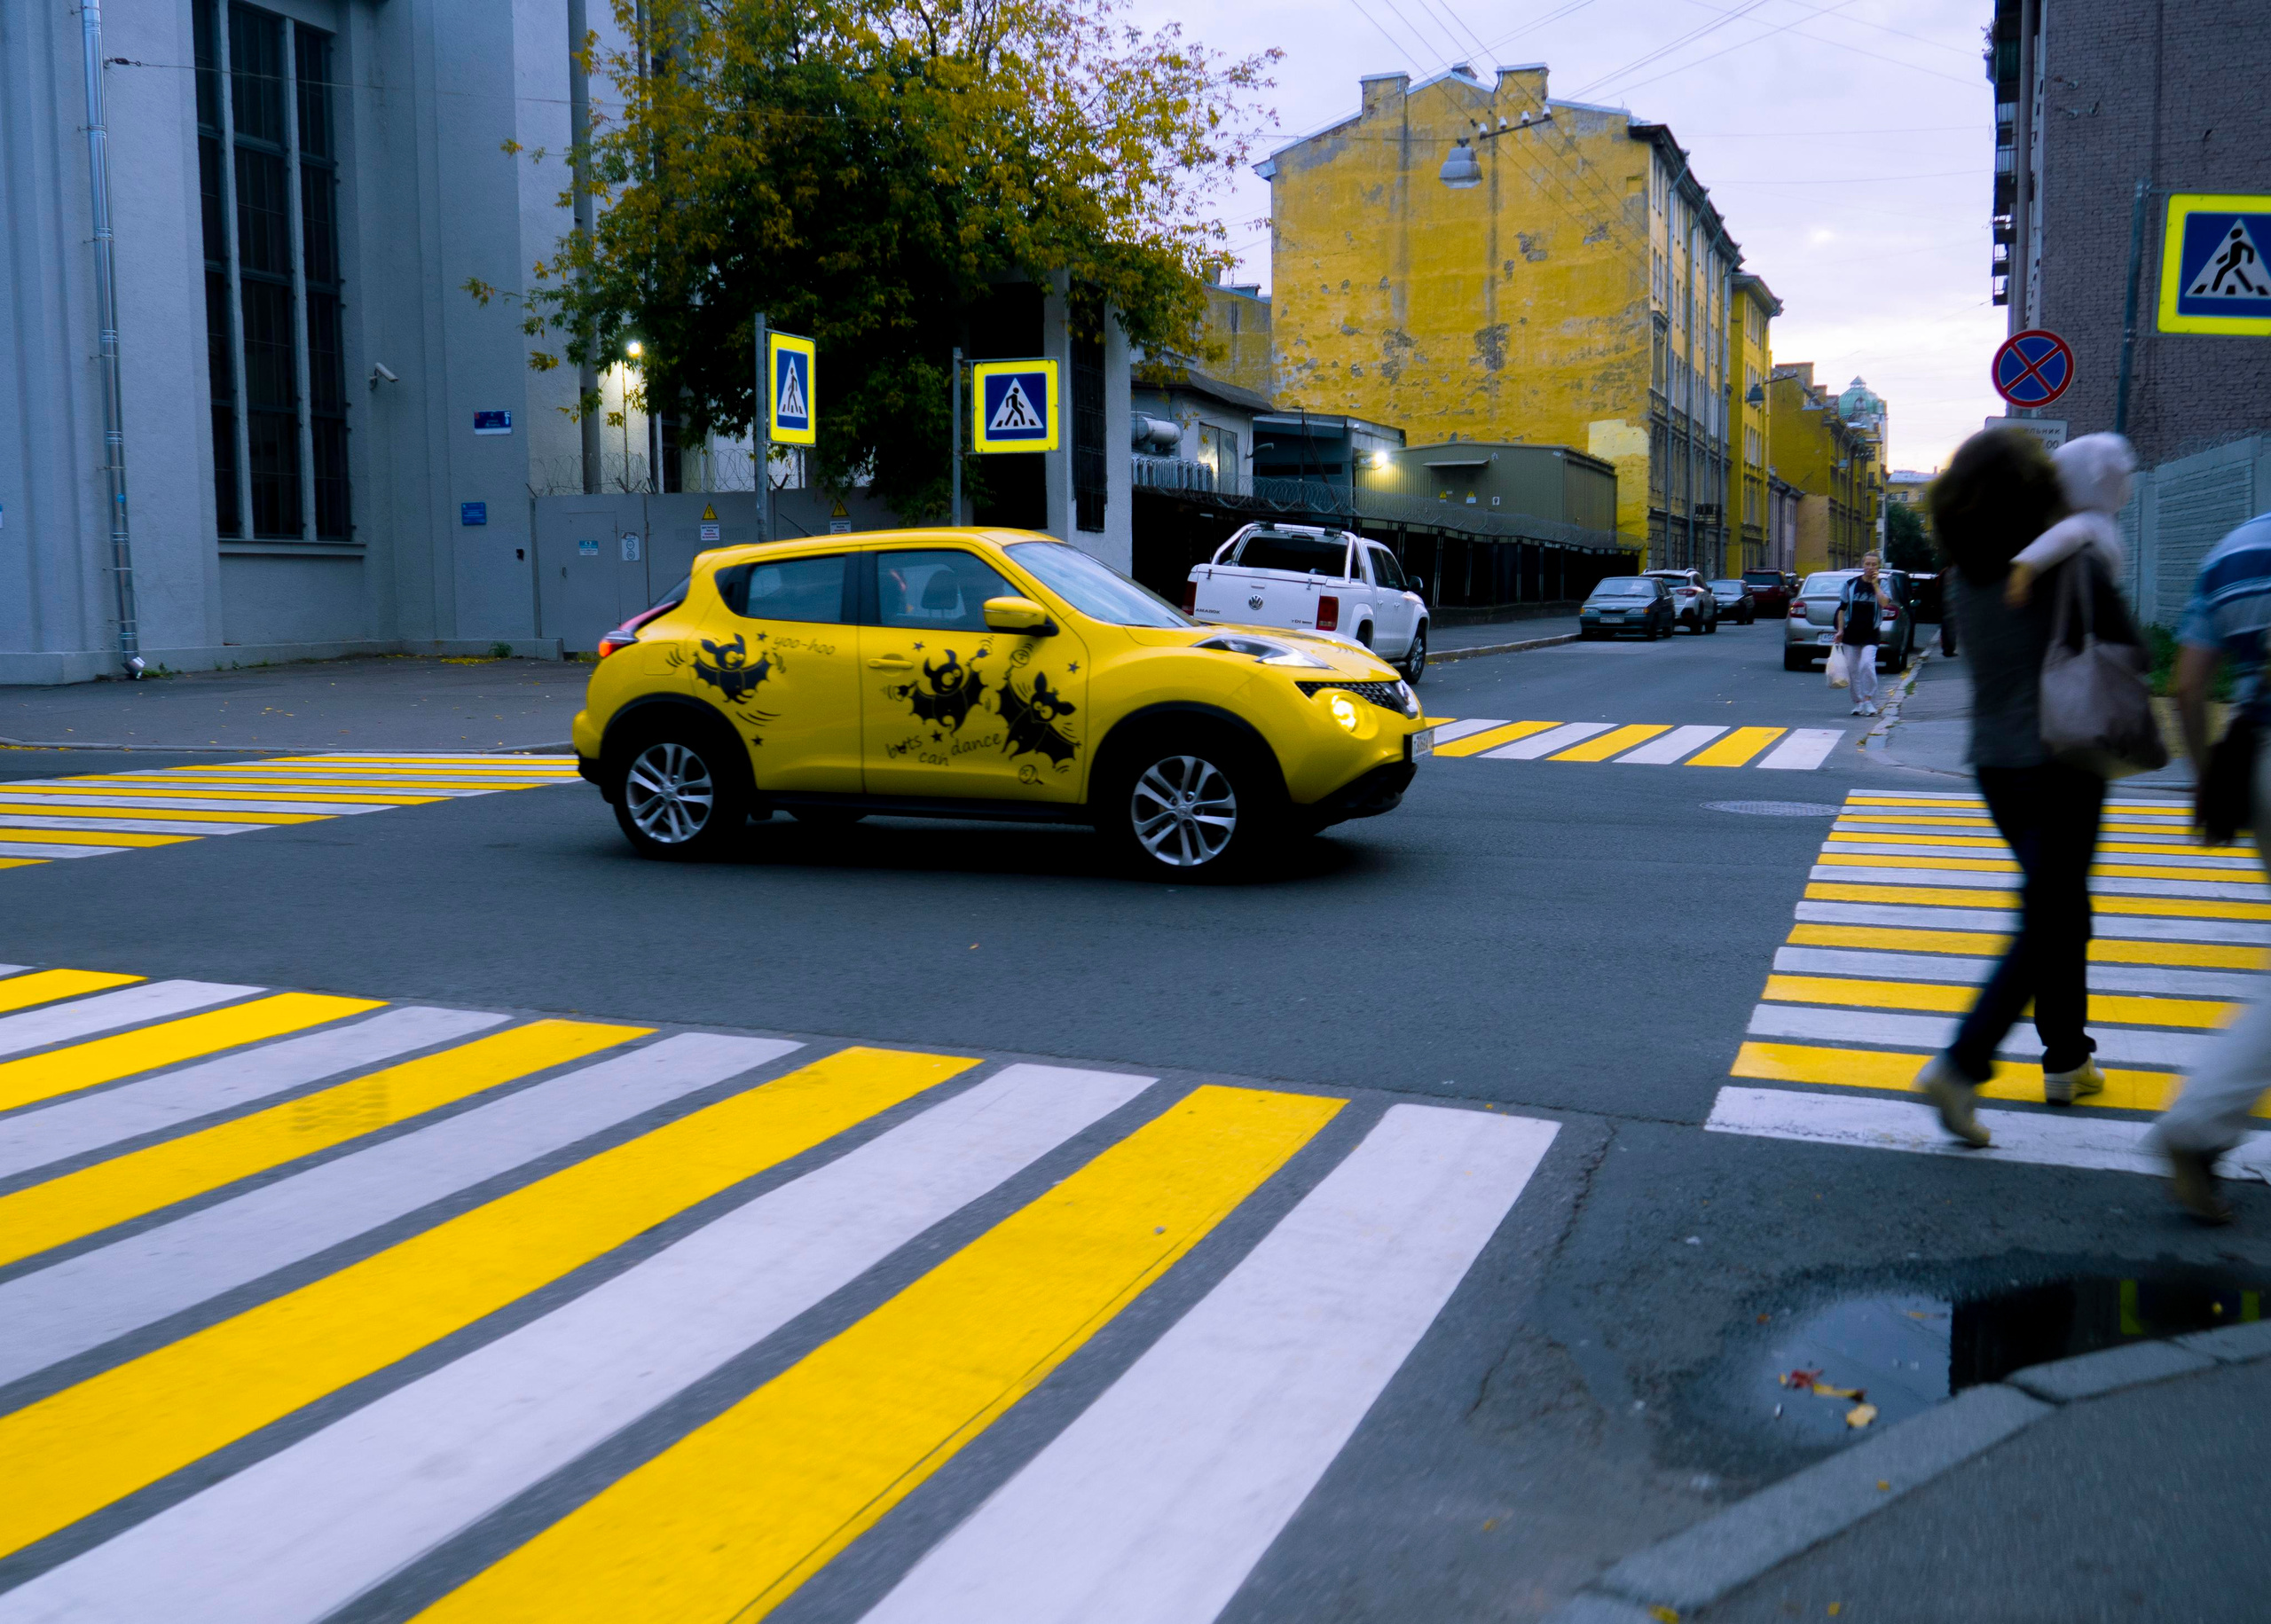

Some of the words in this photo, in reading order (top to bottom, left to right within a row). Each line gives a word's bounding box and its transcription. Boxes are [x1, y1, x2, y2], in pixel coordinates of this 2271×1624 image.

[771, 636, 837, 655] yoo-hoo
[919, 751, 949, 766] can
[950, 733, 1002, 757] dance
